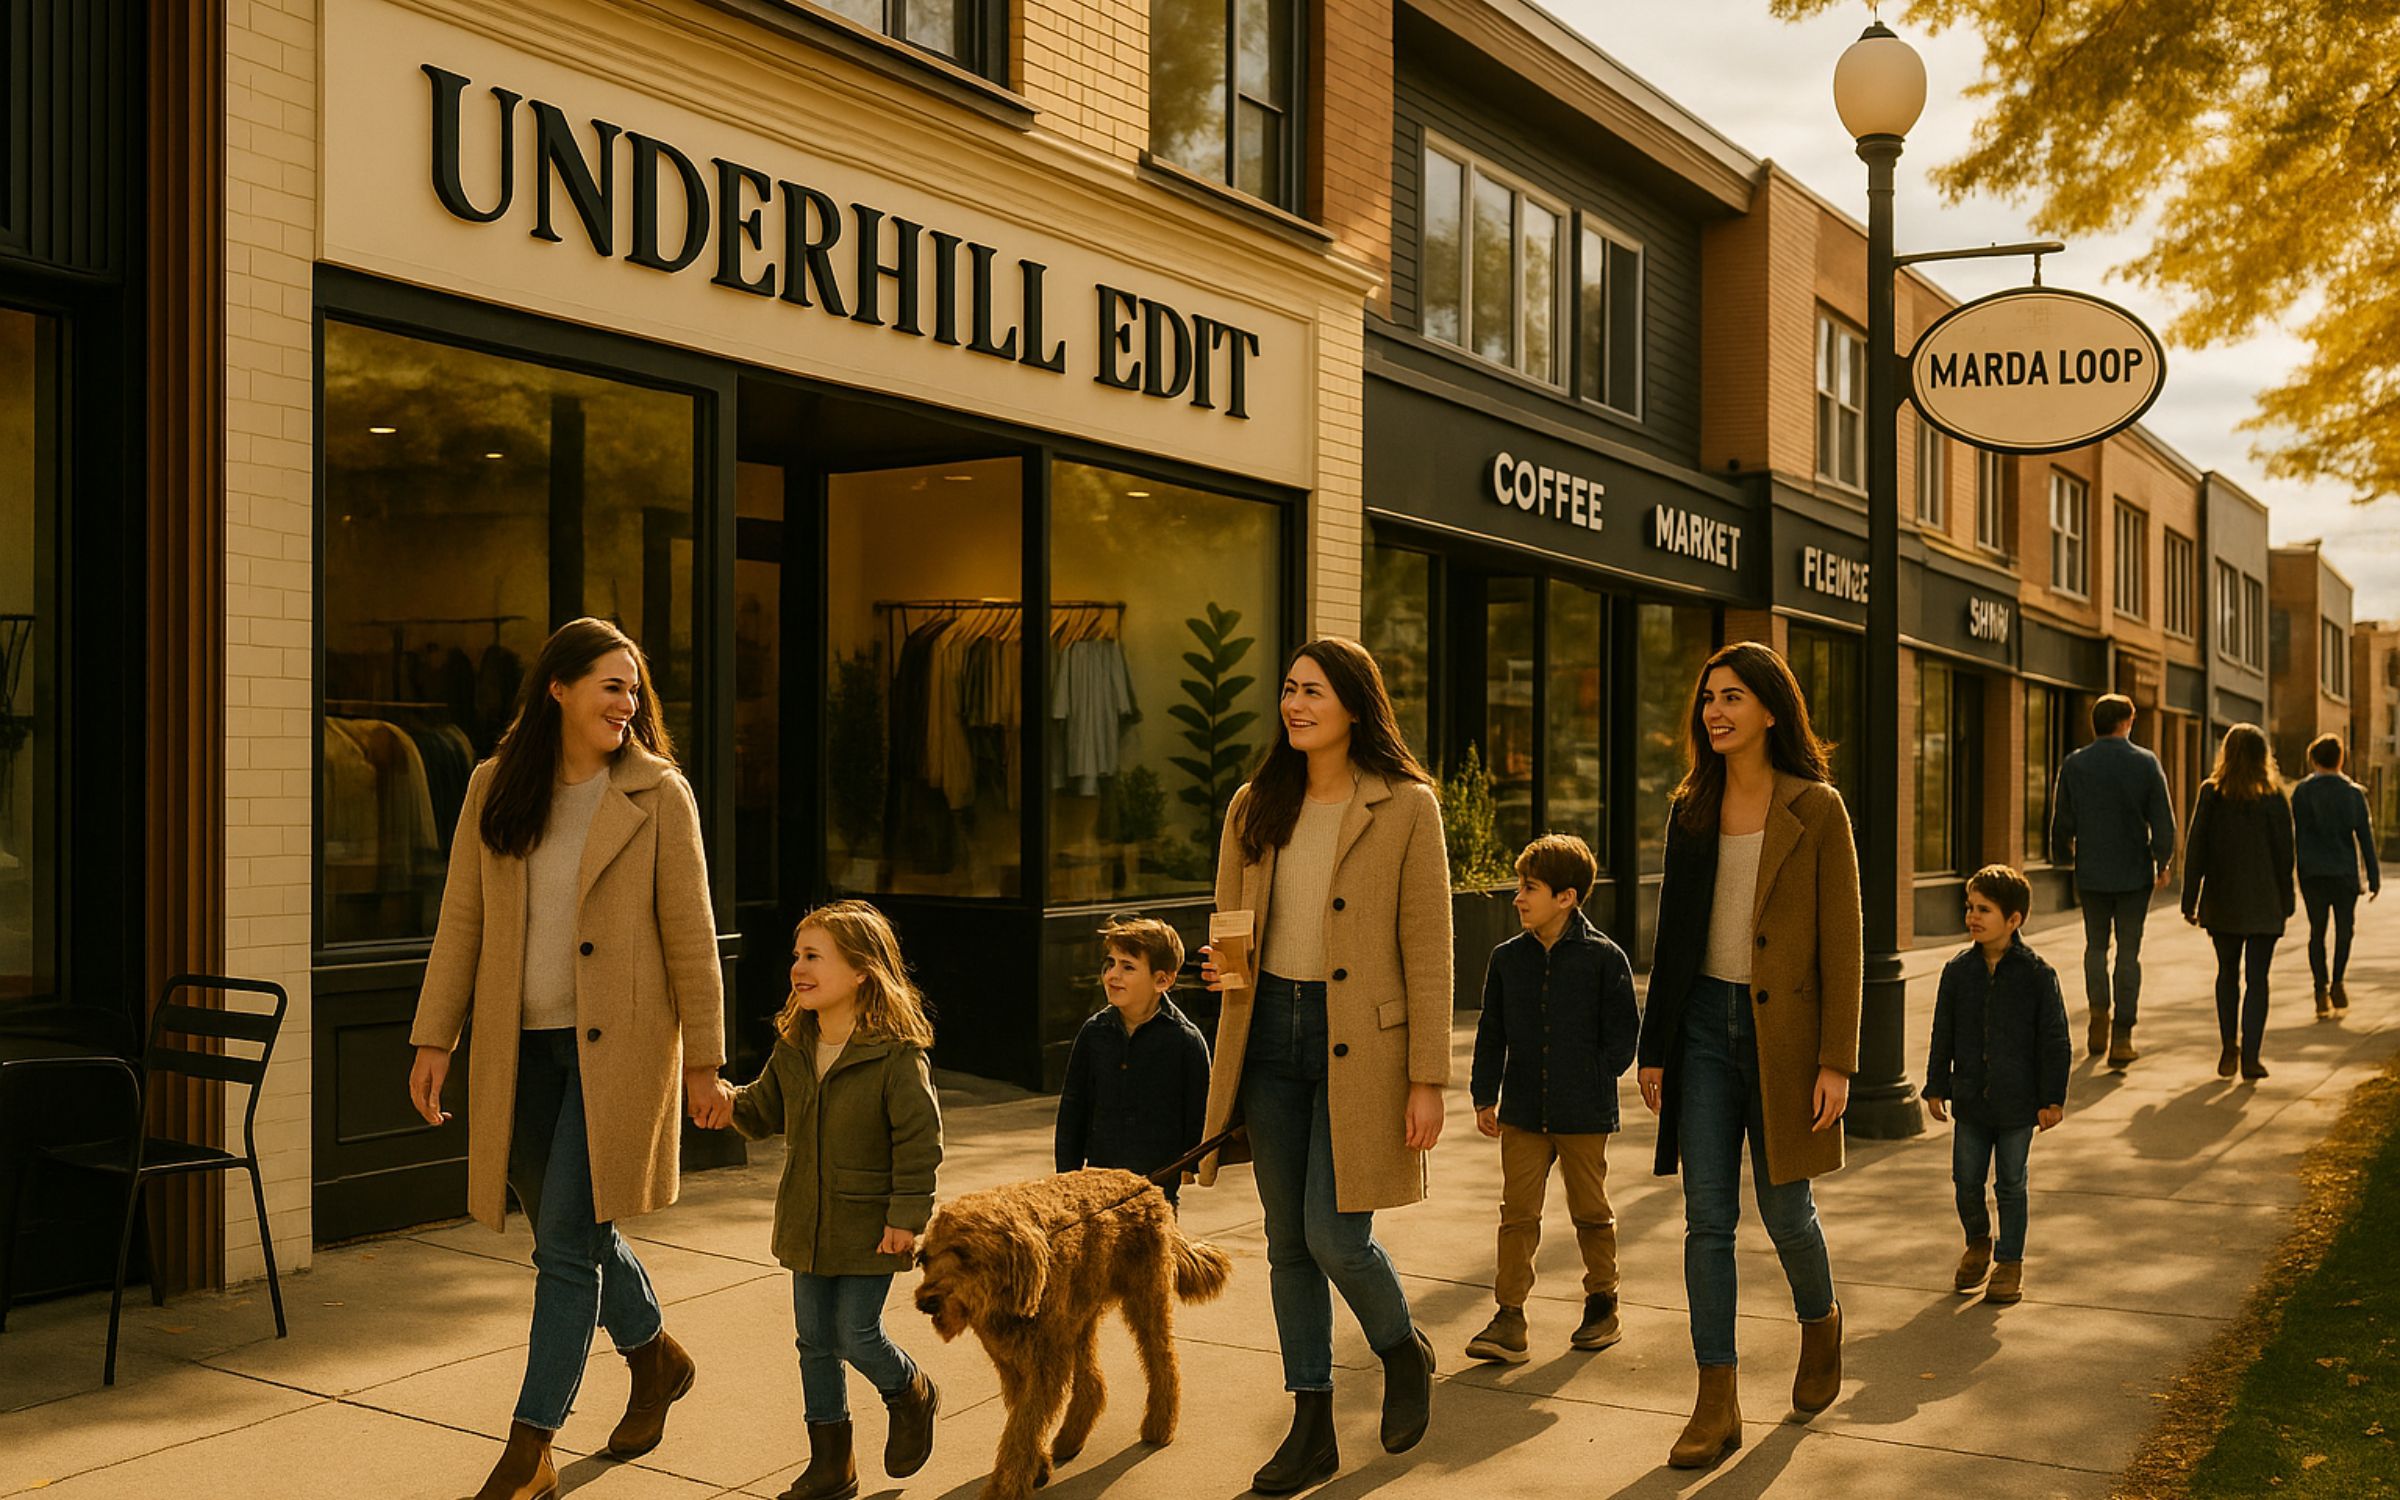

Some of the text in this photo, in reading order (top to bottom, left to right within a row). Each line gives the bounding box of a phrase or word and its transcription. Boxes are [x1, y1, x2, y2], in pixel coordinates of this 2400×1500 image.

[420, 63, 1260, 420] UNDERHILL EDIT
[1930, 347, 2144, 389] MARDA LOOP
[1493, 451, 1742, 571] COFFEE MARKET
